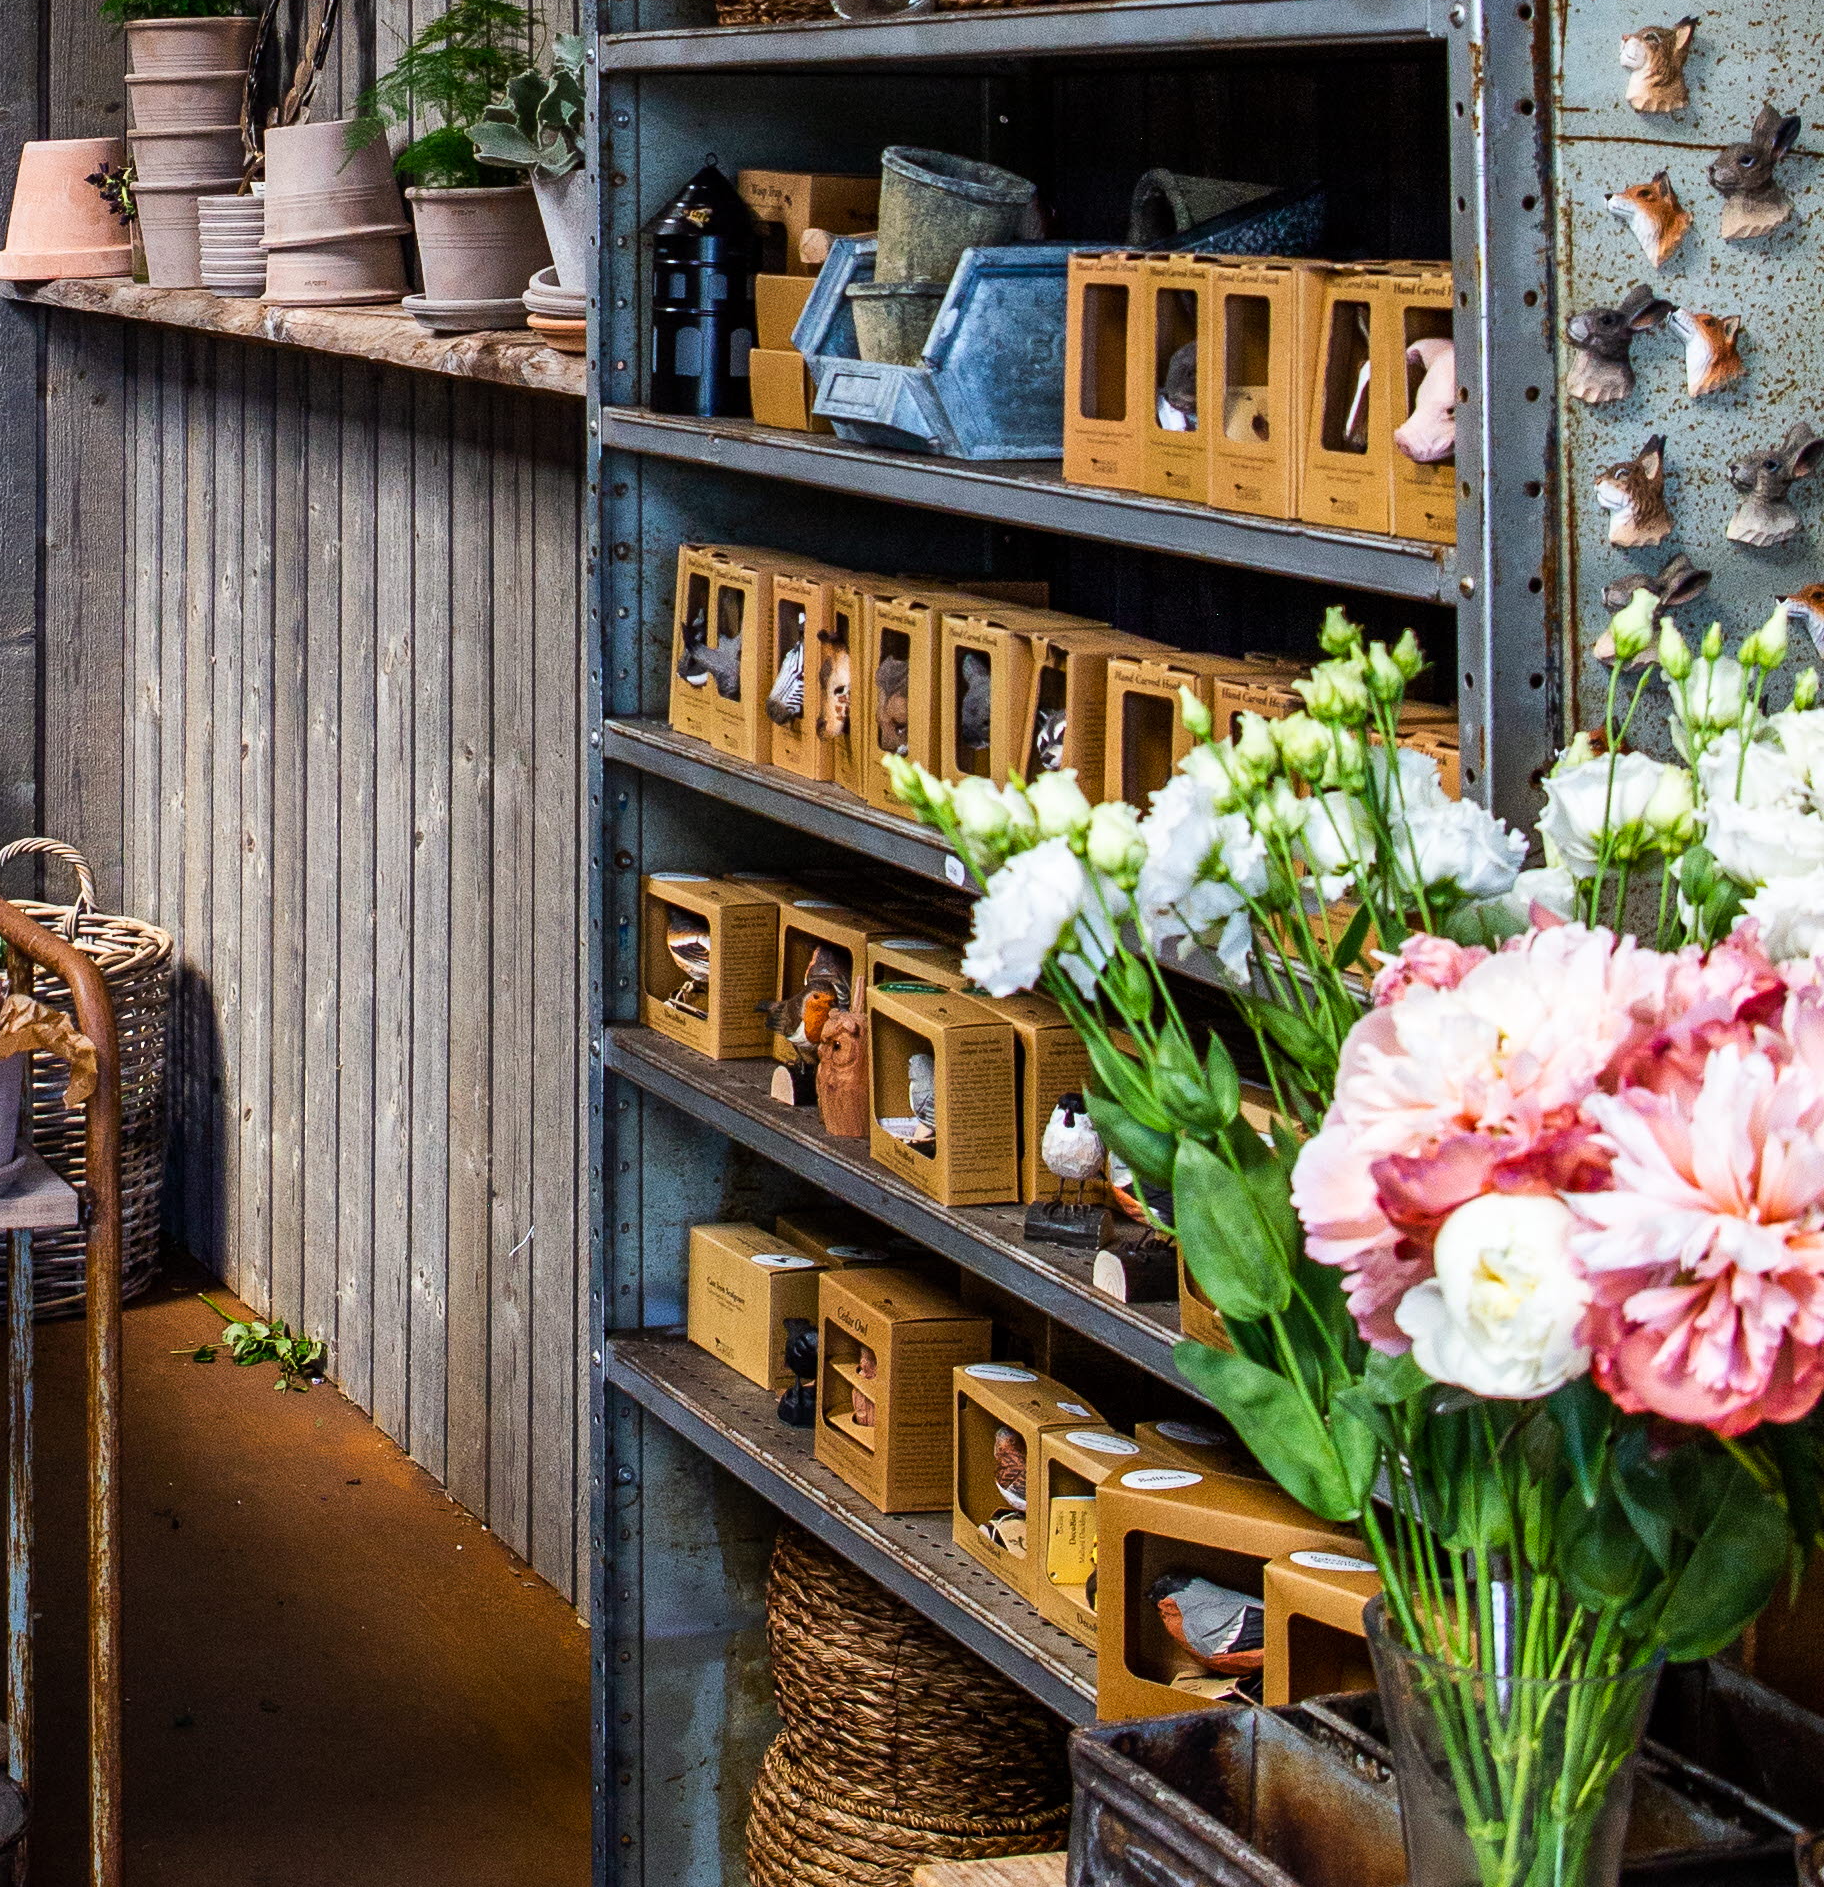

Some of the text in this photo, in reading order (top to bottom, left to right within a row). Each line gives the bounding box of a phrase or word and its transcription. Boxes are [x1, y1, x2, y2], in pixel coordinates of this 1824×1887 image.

[1393, 282, 1416, 295] Hand
[854, 1318, 868, 1337] Owl
[1068, 1510, 1077, 1546] DecoBird
